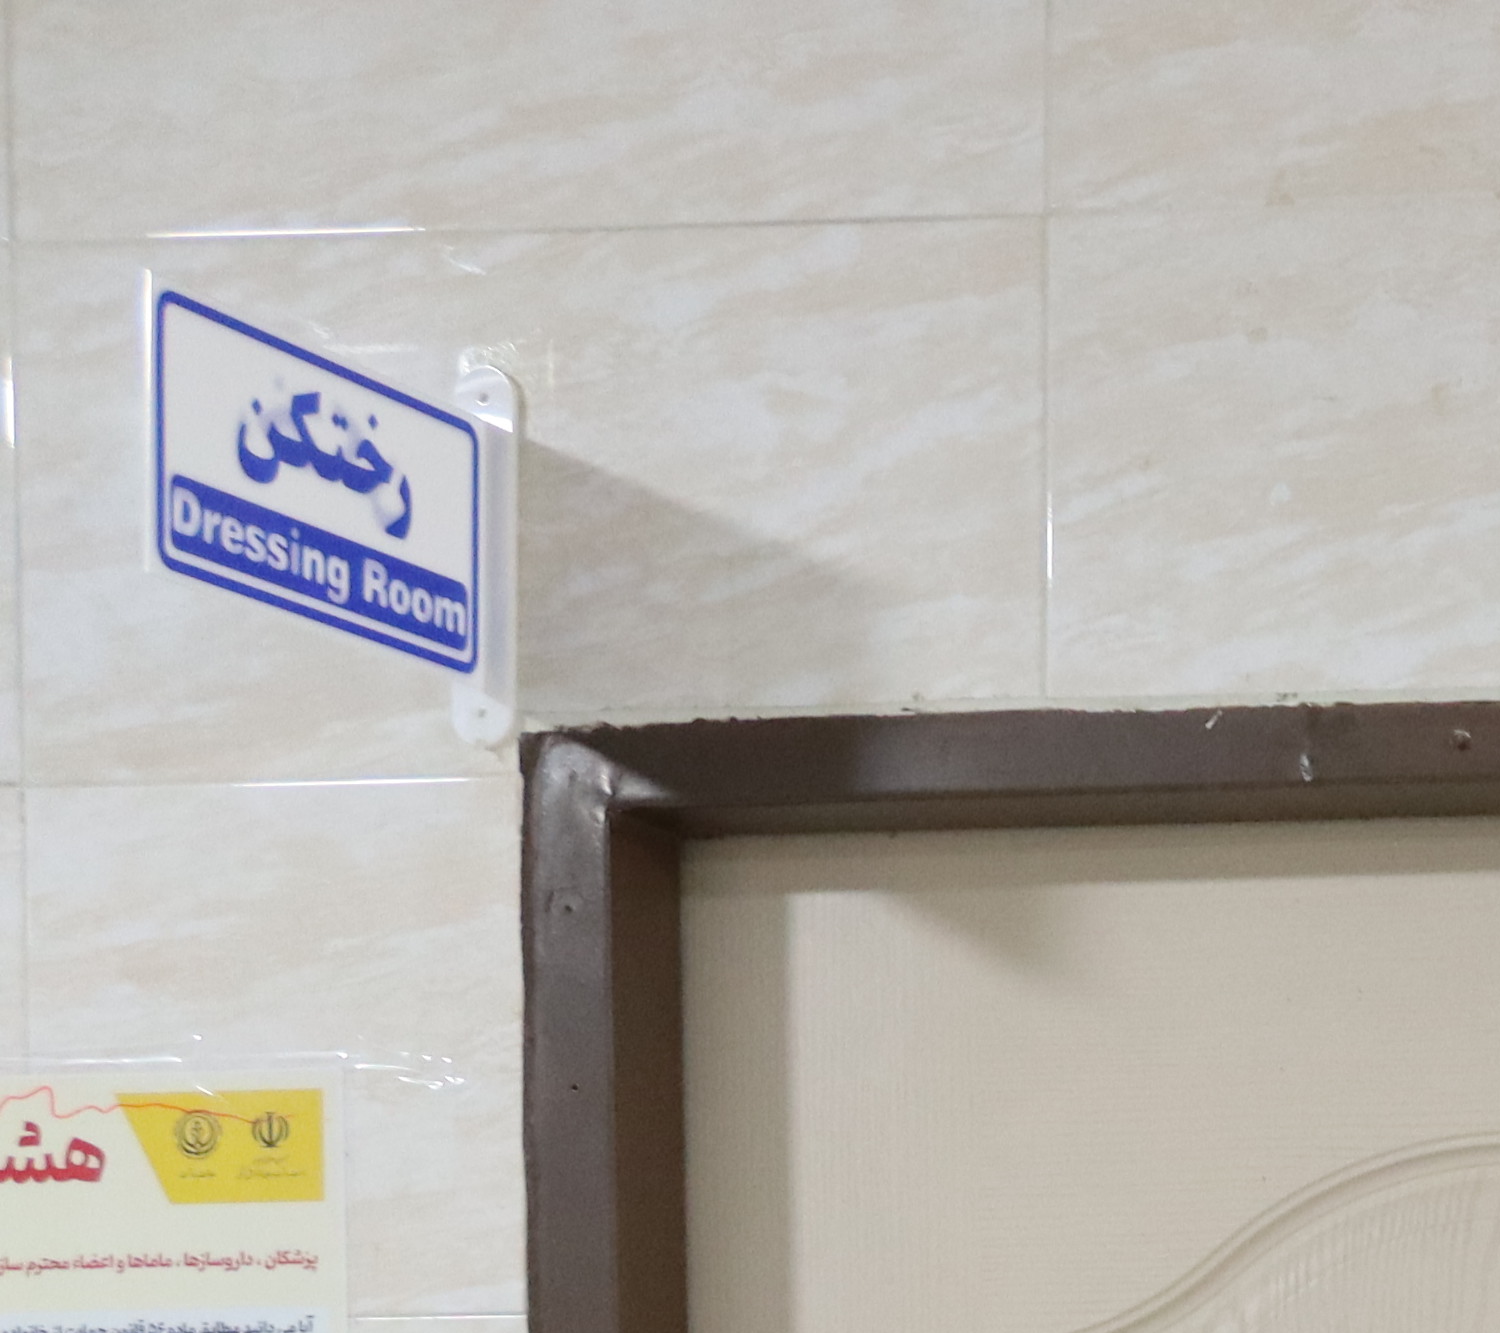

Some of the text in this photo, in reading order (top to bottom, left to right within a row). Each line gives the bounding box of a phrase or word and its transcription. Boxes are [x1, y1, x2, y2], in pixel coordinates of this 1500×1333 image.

[237, 391, 412, 540] رختکن
[170, 490, 467, 636] Dressing Room
[0, 1120, 106, 1183] هش
